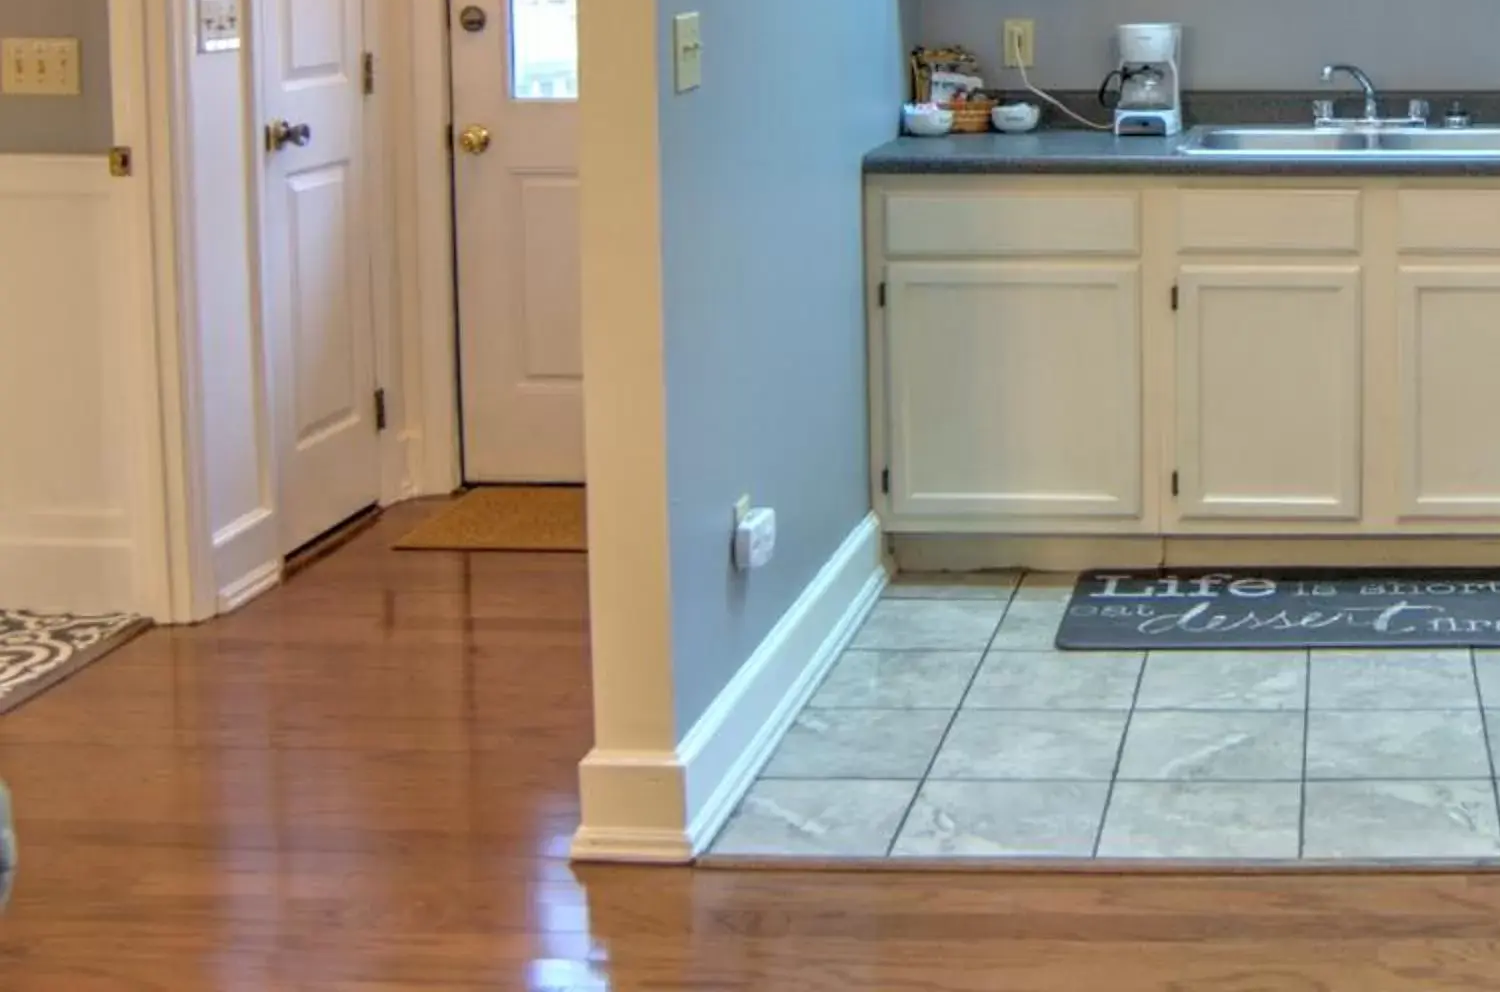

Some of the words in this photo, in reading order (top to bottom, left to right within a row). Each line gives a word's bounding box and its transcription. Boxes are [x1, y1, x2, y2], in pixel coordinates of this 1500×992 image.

[1090, 573, 1276, 597] Life
[1294, 583, 1337, 596] is
[1068, 604, 1155, 618] eat
[1137, 601, 1445, 634] dessert
